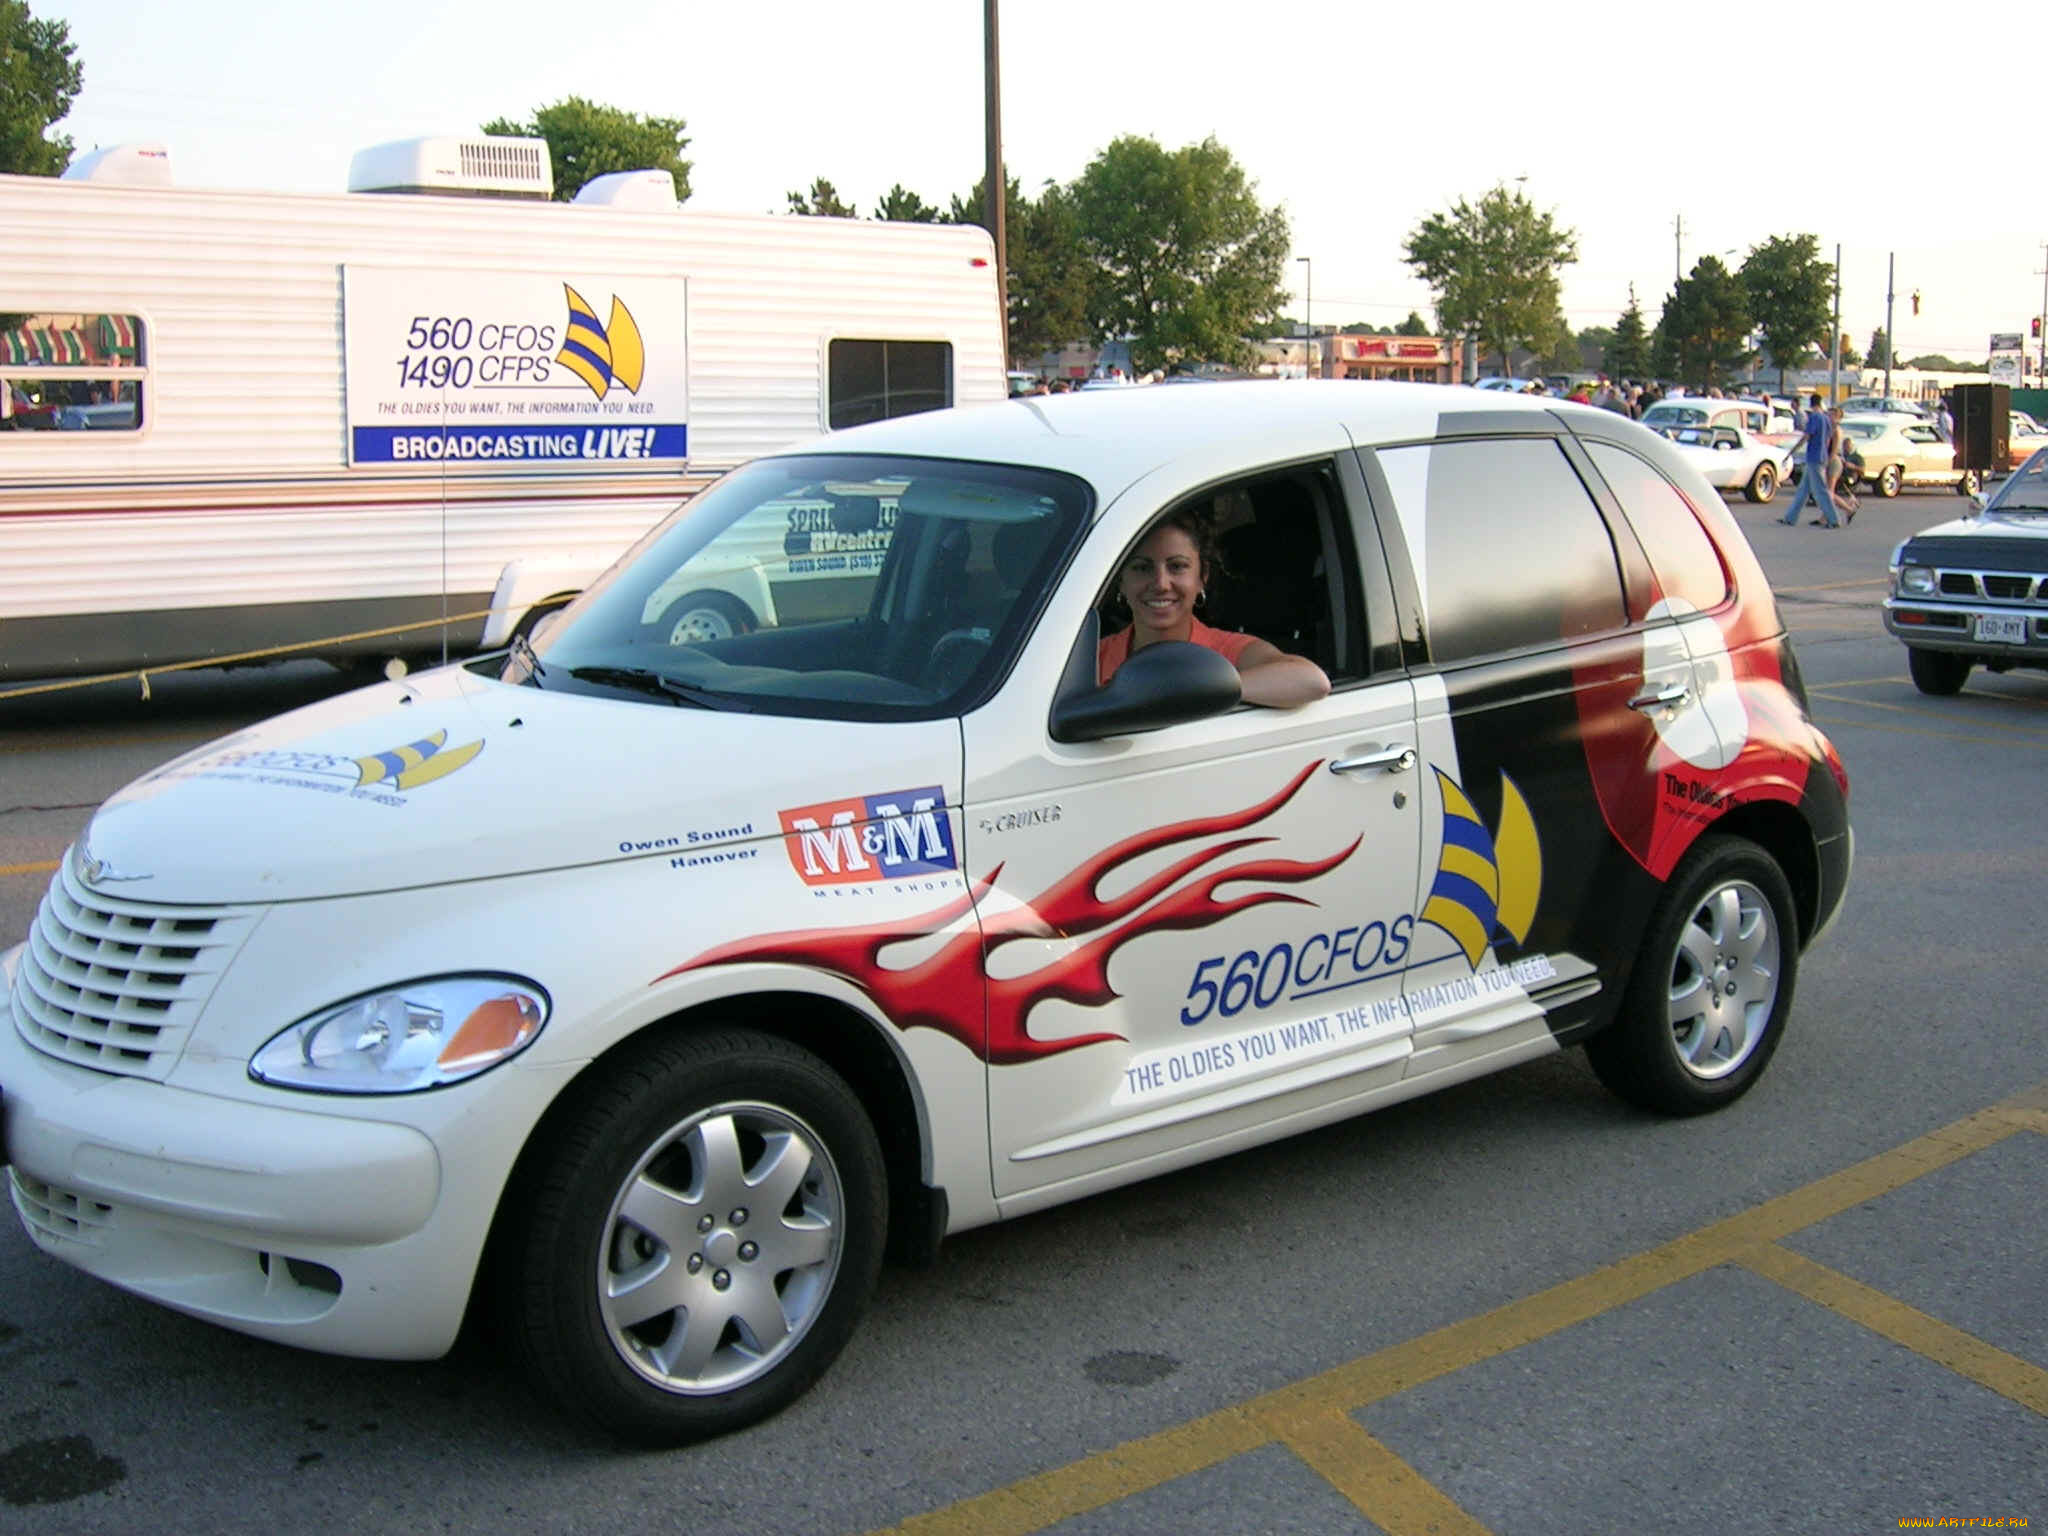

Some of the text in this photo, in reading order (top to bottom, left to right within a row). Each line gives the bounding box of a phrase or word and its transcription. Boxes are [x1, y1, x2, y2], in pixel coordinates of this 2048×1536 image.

[407, 317, 554, 351] 560 CFOS
[397, 355, 550, 388] 1490 CFPS
[378, 402, 397, 414] THE
[401, 402, 440, 414] OLDIES
[443, 402, 465, 414] YOU
[507, 402, 525, 414] THE
[528, 402, 598, 414] INFORMATION
[602, 402, 623, 414] YOU
[392, 428, 656, 459] BROADCASTING LIVE!
[619, 823, 753, 853] Owen Sound
[670, 849, 758, 868] Hanover
[814, 879, 963, 898] MEAT SHOPS
[1127, 1062, 1164, 1094] THE
[1169, 1043, 1236, 1082] OLDIES
[1238, 1032, 1277, 1062] YOU
[1279, 1016, 1336, 1052] WANT,
[1338, 1008, 1370, 1035] THE
[1372, 977, 1478, 1025] INFORMATION
